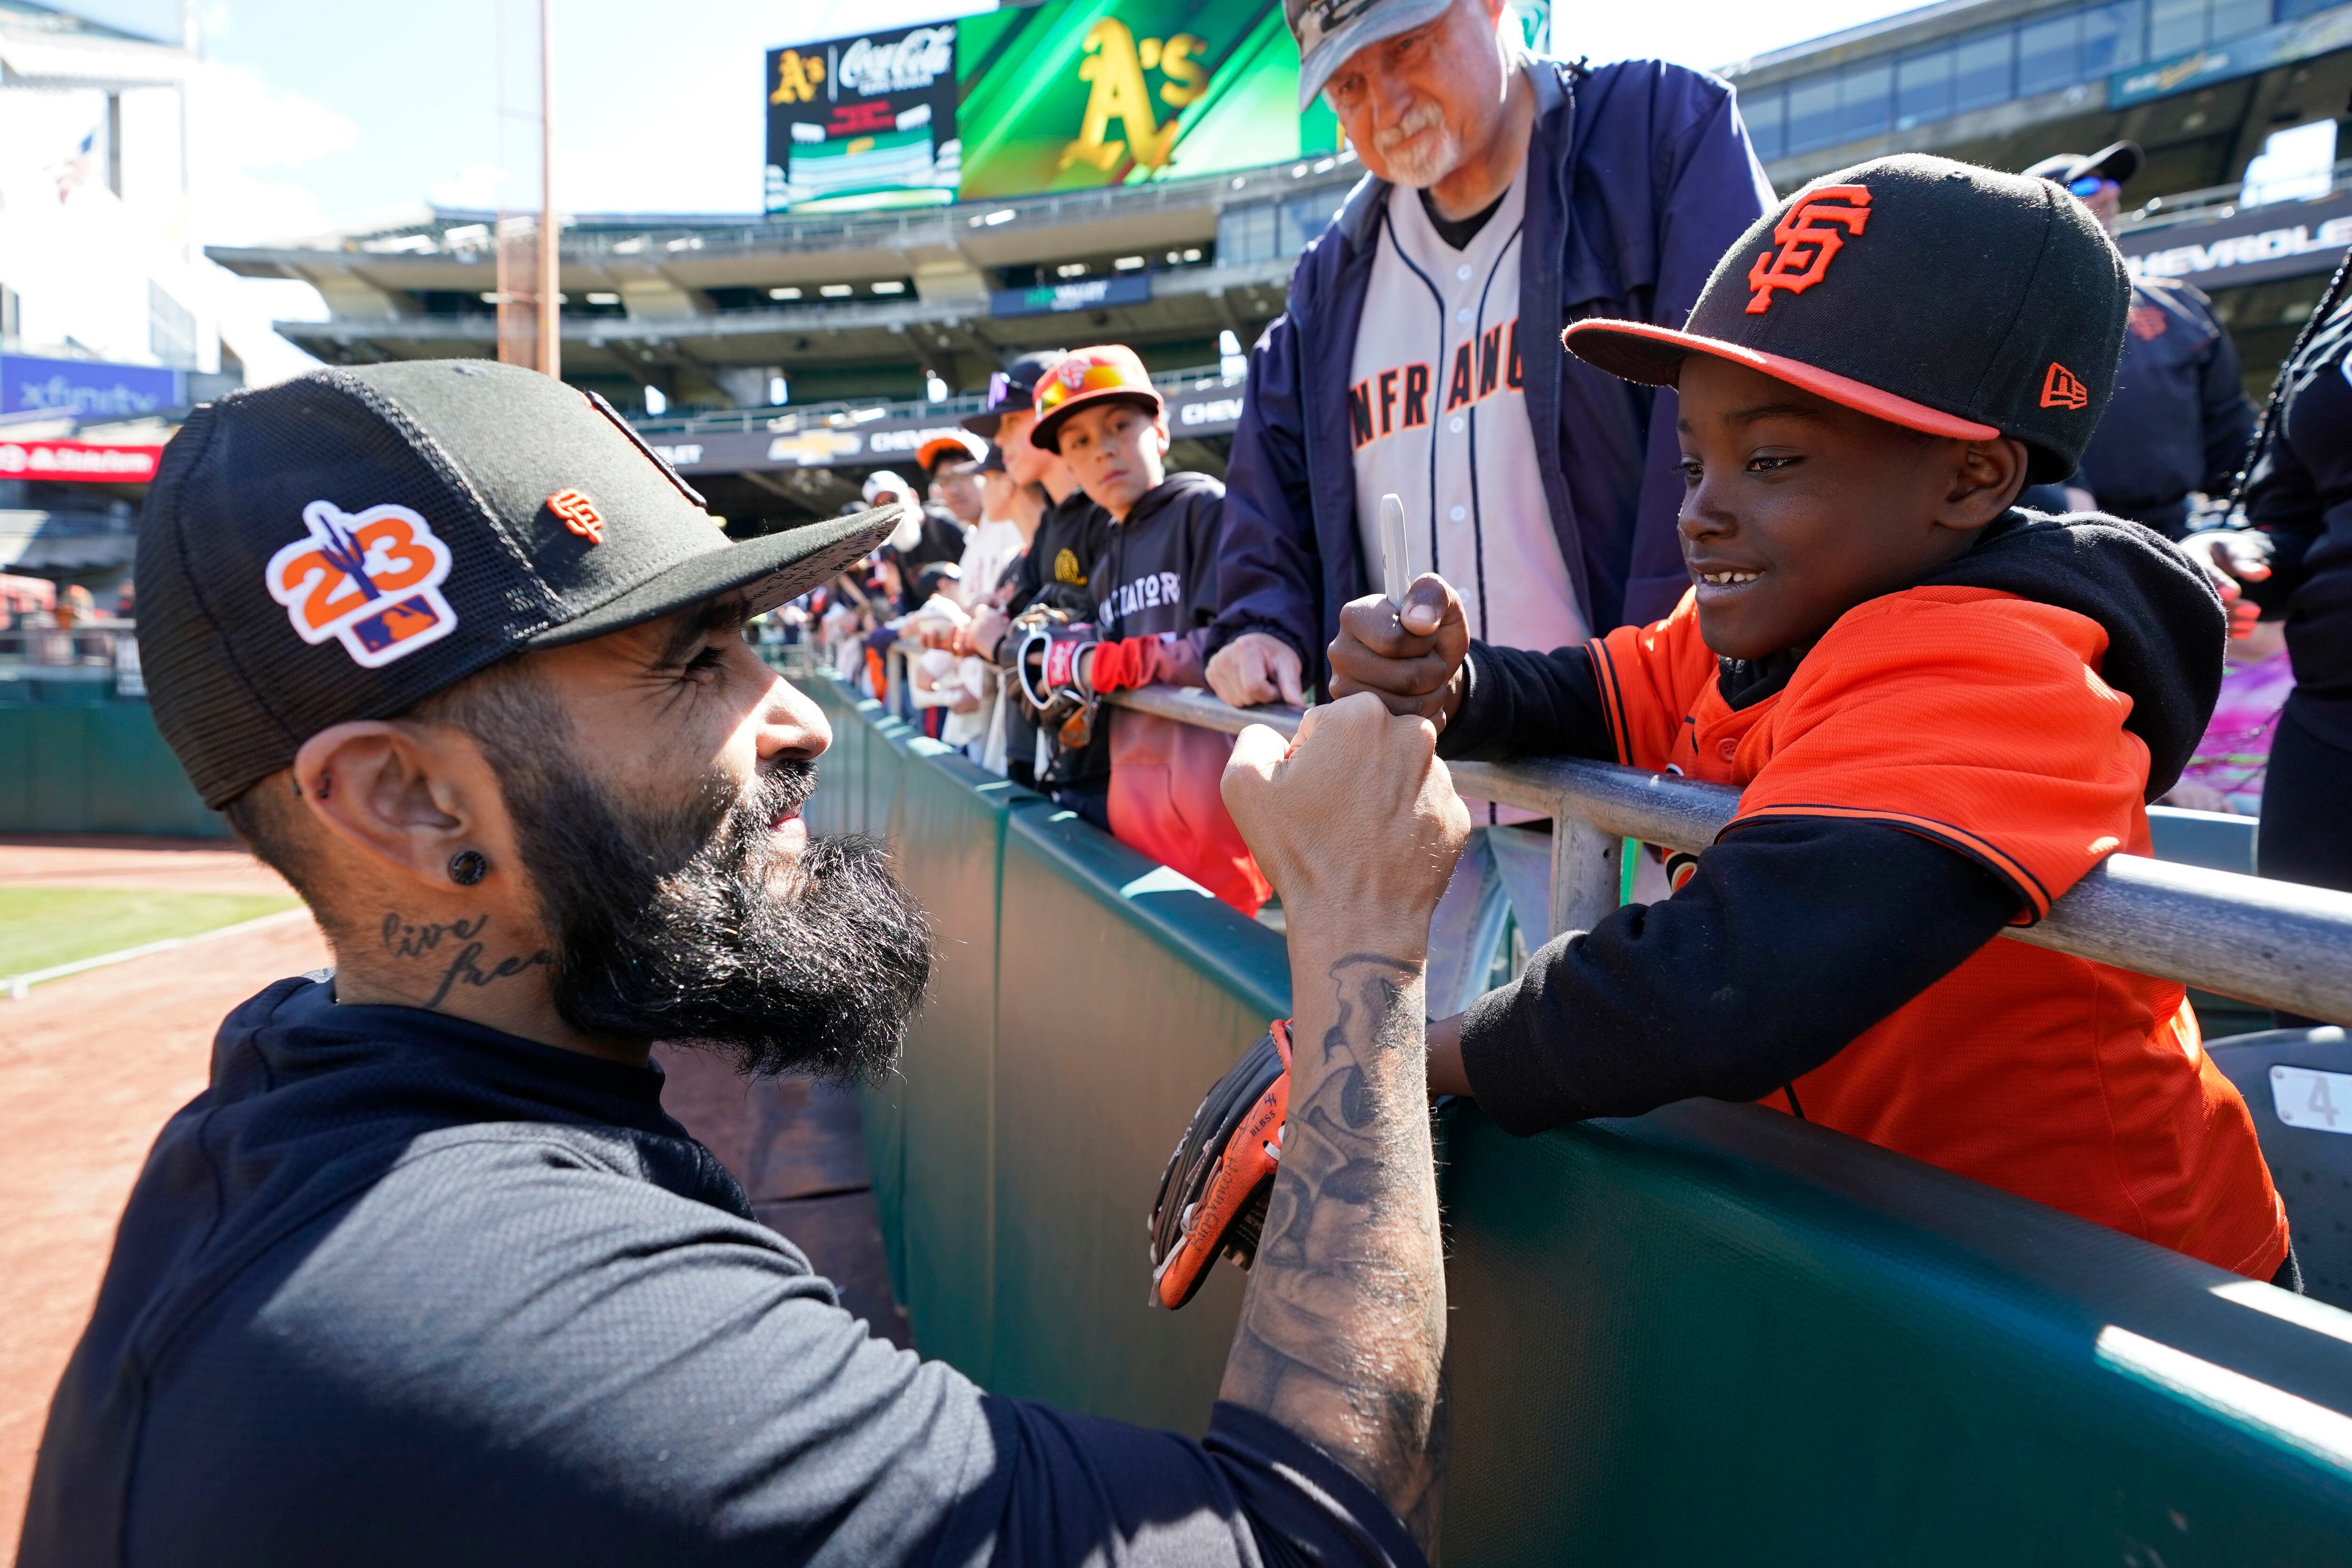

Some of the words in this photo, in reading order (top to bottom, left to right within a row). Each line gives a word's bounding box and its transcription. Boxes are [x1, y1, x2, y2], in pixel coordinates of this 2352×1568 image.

[770, 49, 826, 104] A's
[839, 24, 957, 88] Coca-Cola
[1058, 16, 1210, 171] A's
[1745, 183, 1873, 314] SF
[2125, 215, 2352, 279] HEVROLE
[22, 375, 160, 415] xfinity
[546, 487, 604, 544] SF
[282, 517, 436, 630] 23
[381, 912, 489, 958] live
[2308, 1076, 2340, 1127] 4
